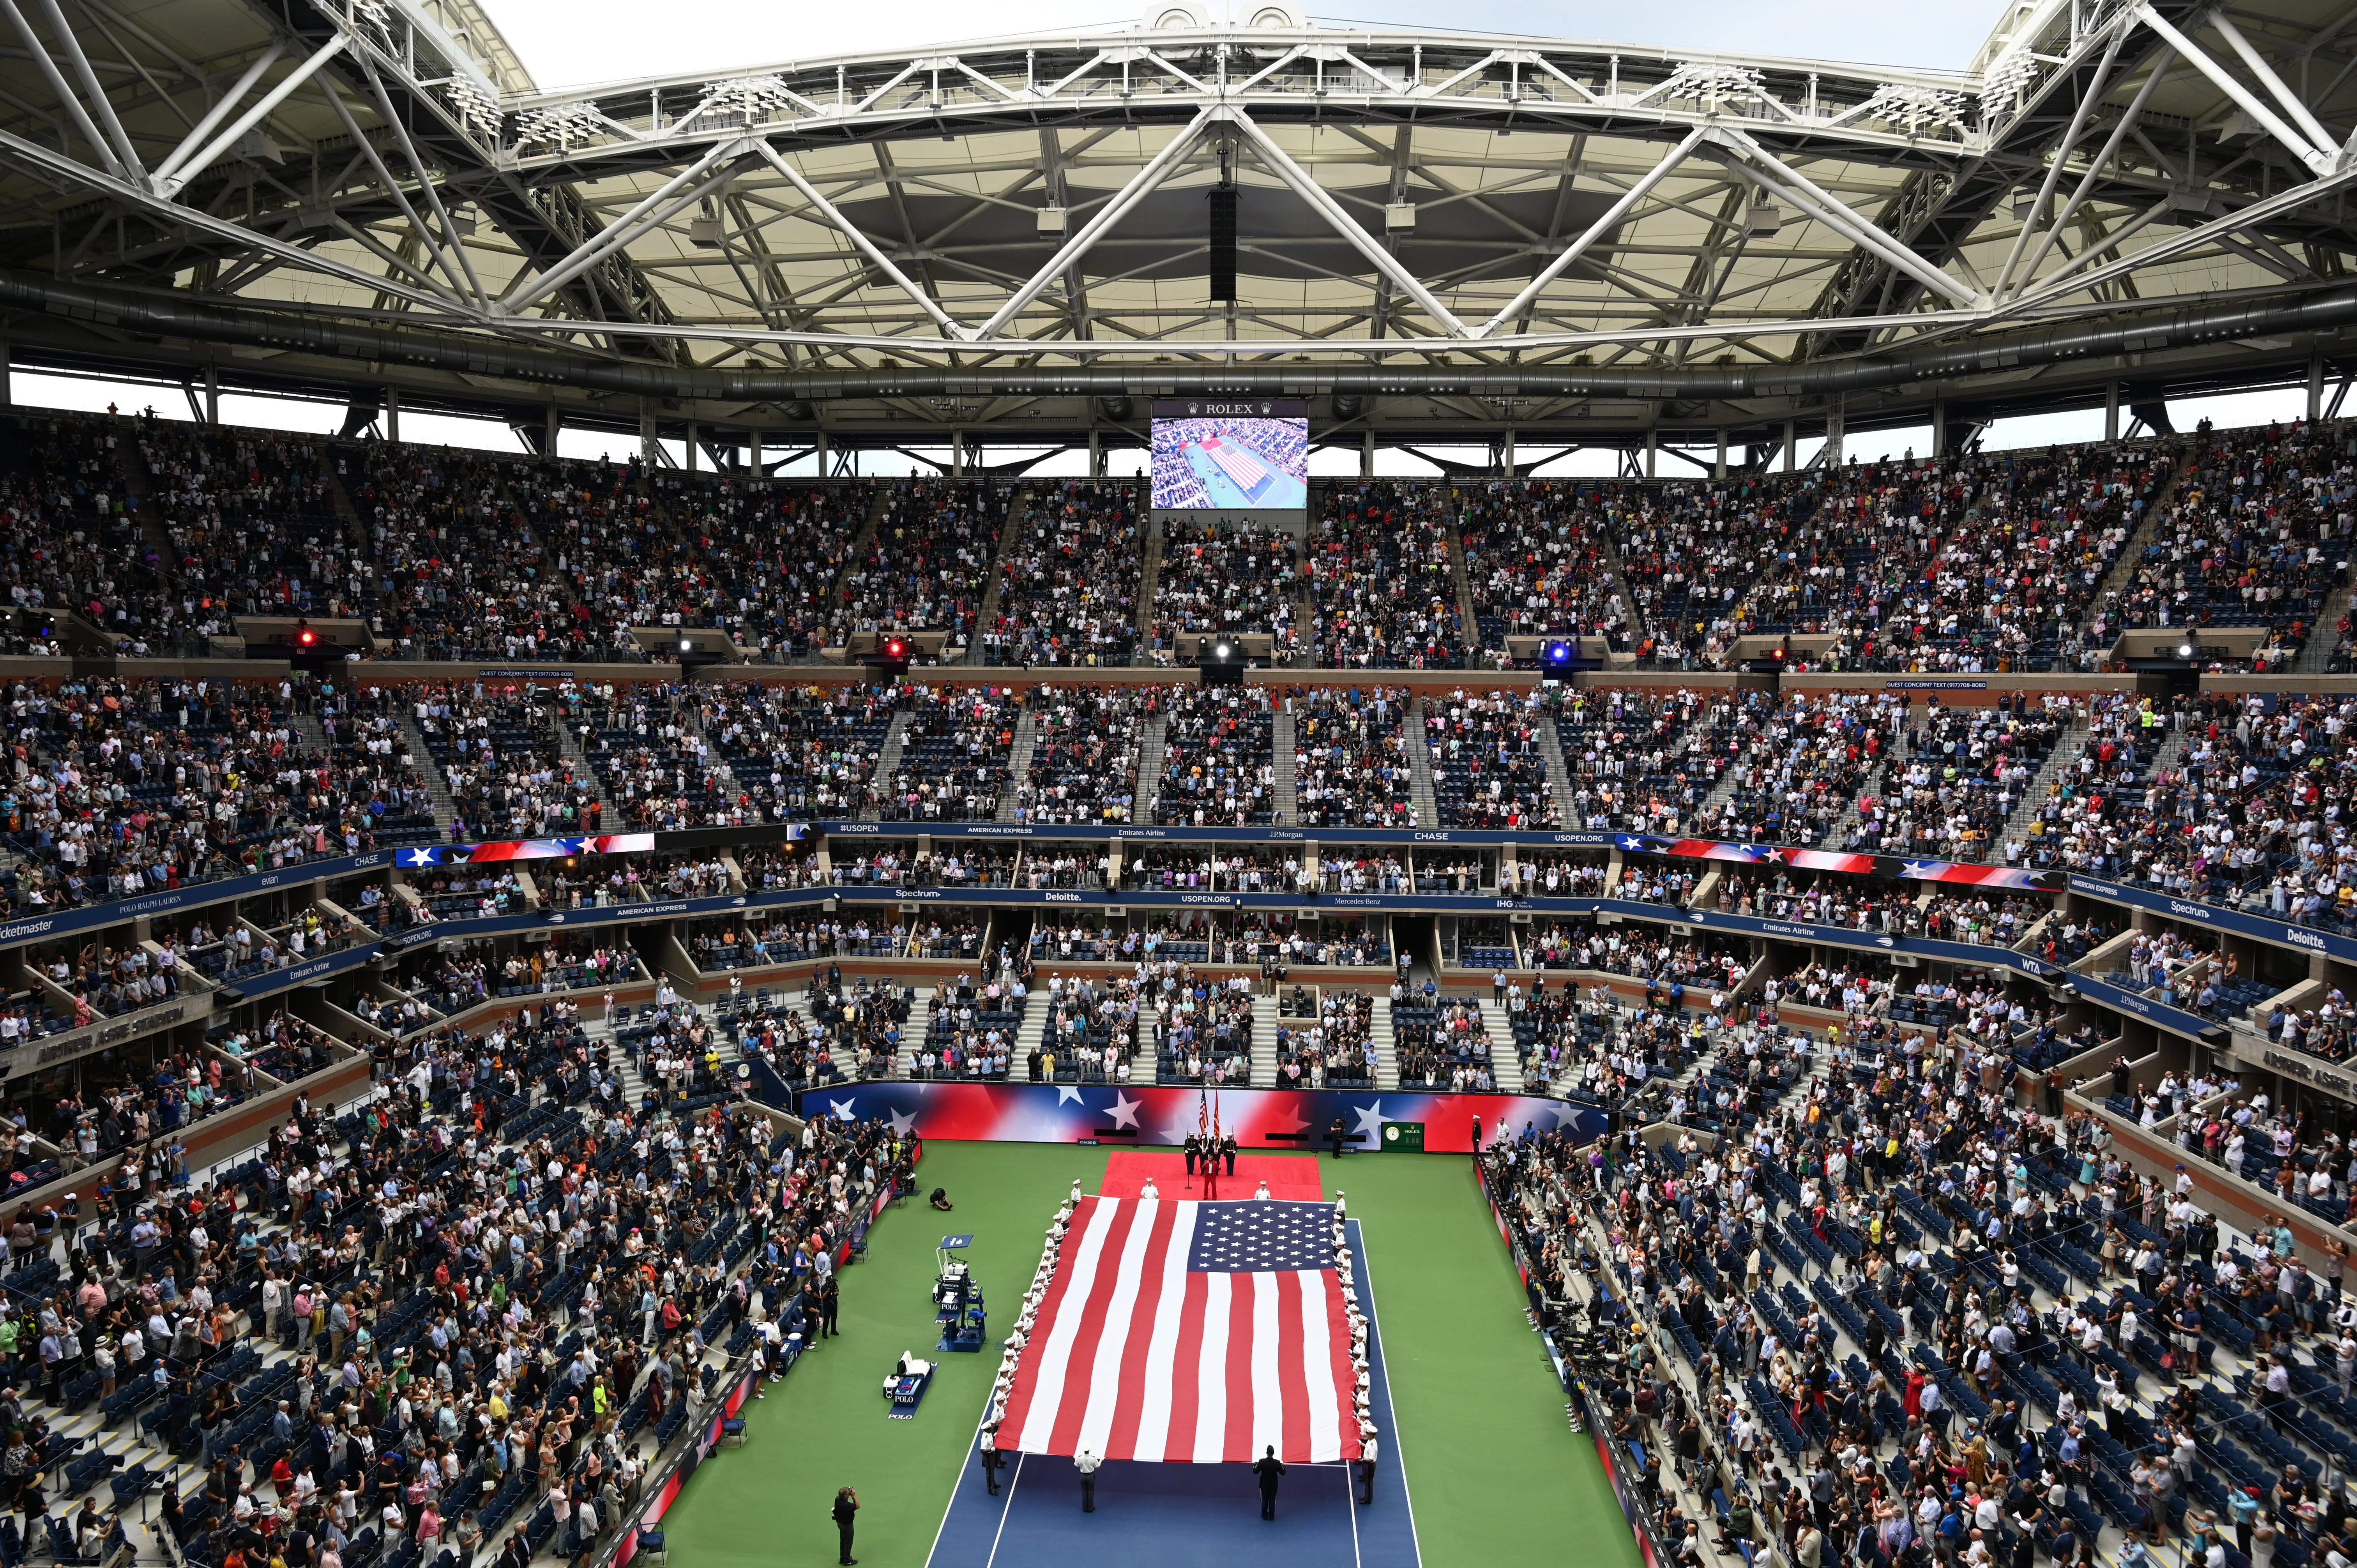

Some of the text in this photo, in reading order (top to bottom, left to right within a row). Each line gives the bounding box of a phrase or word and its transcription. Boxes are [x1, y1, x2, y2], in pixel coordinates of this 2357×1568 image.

[1206, 404, 1253, 413] ROLEX
[1269, 831, 1303, 839] J.P.Morgan
[355, 854, 378, 867] CHASE
[261, 875, 278, 886] evian
[2071, 879, 2118, 896] AMERICAN EXPRESS
[896, 889, 938, 898] Spectrum
[1046, 892, 1081, 901] Deloitte.
[120, 895, 181, 914] POLO RALPH LAUREN
[617, 904, 687, 916] AMERICAN EXPRESS
[2171, 901, 2207, 918] Spectrum
[1763, 923, 1815, 936] Emirates Airline
[2287, 929, 2325, 949] Deloitte.
[290, 962, 330, 980] Emirates Airline
[2022, 958, 2041, 975] WTA
[2120, 995, 2148, 1012] J.P.Morgan
[37, 1007, 184, 1065] ARTHUR ASHE STADIUM
[2263, 1050, 2312, 1081] ARTHUR
[2313, 1069, 2350, 1095] ASHE
